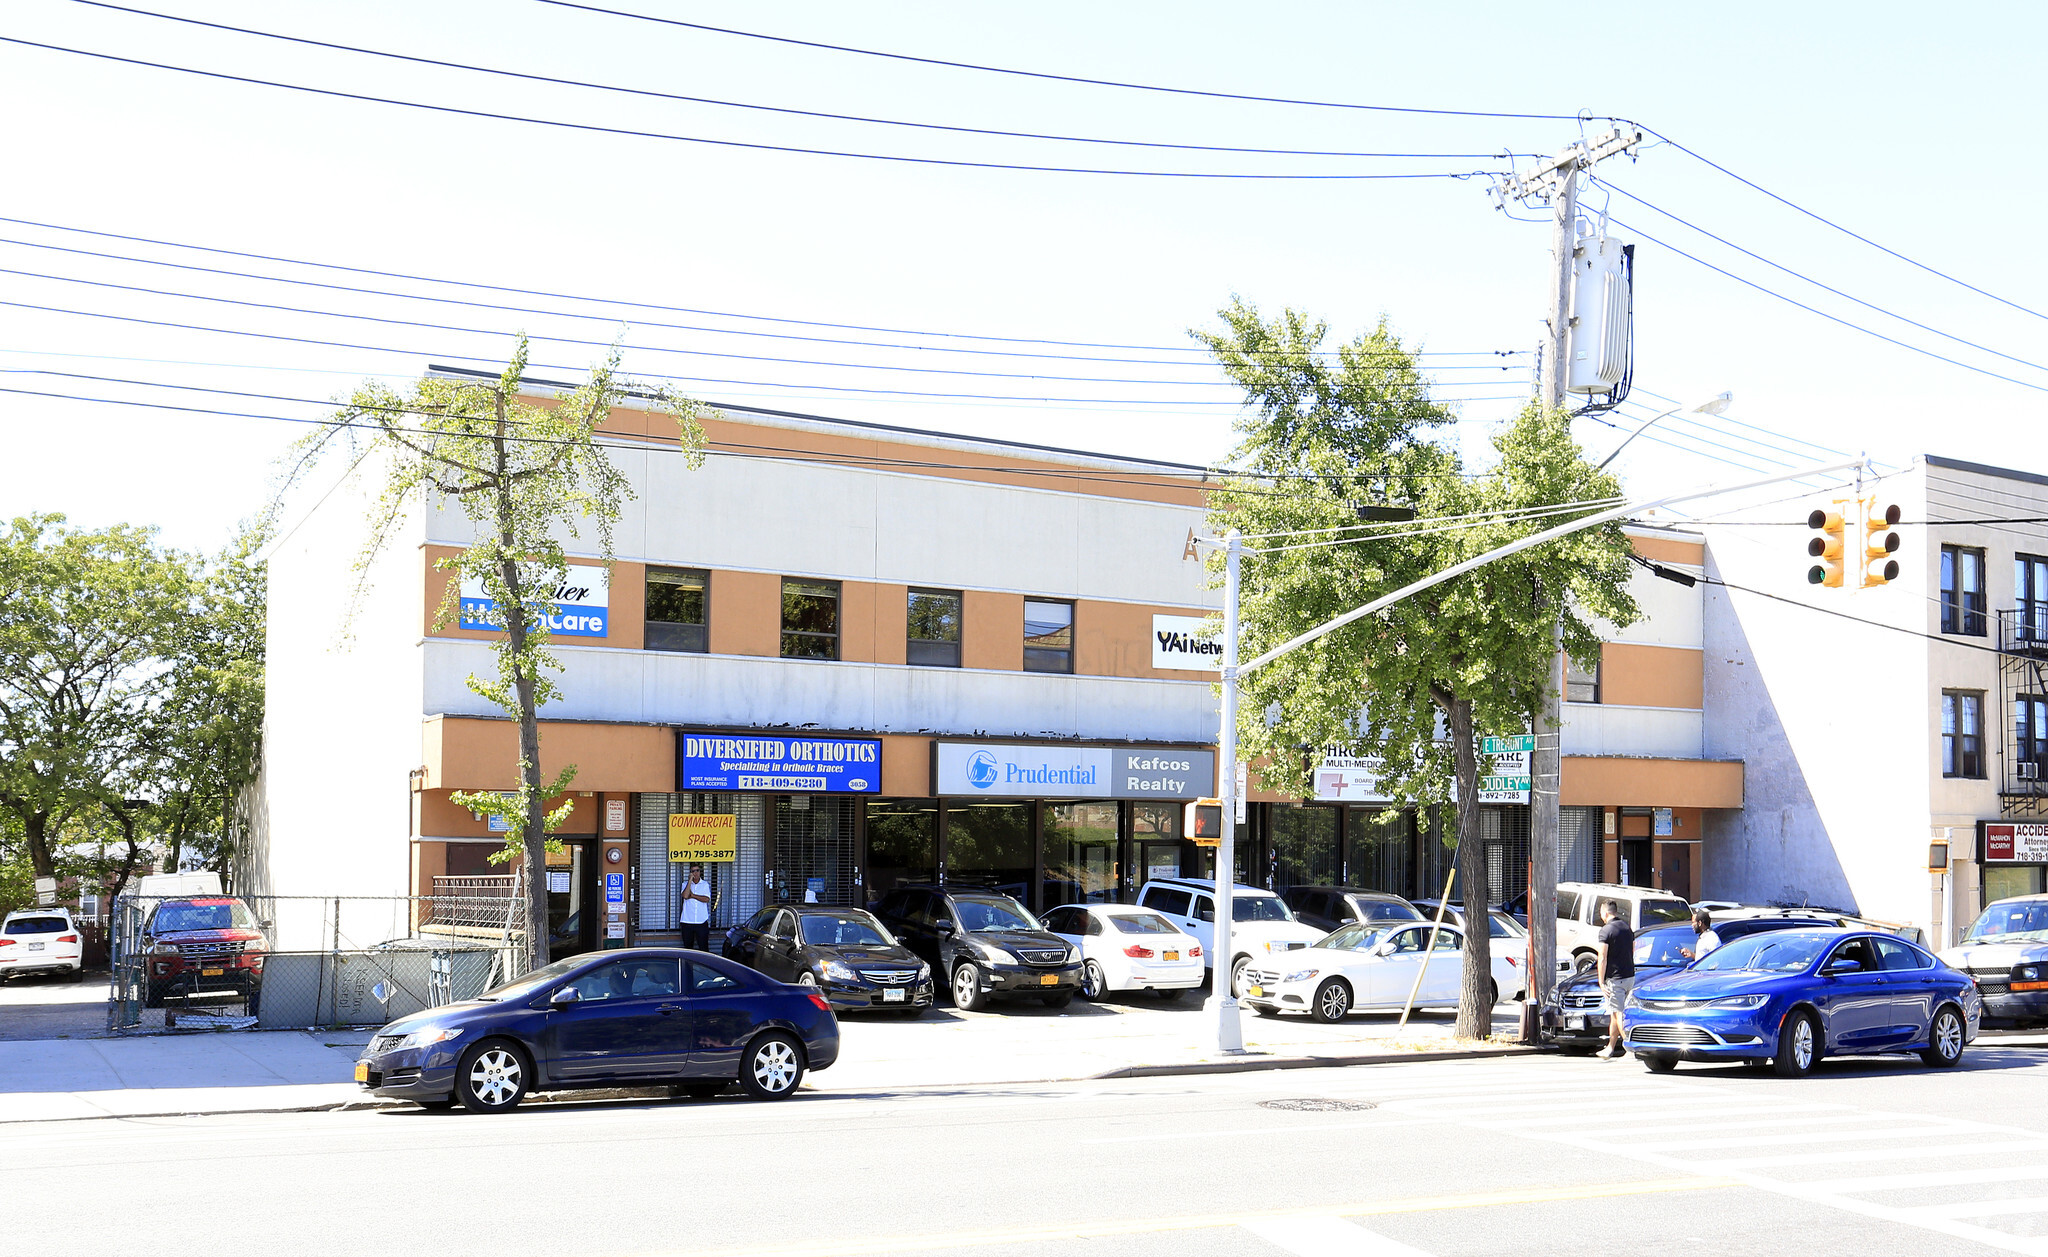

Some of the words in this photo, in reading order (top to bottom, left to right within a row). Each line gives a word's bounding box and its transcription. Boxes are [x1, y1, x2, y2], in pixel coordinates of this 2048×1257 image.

[1190, 638, 1224, 655] Netw
[686, 738, 785, 760] DIVERSIFIED
[790, 741, 876, 763] ORTHOTICS
[1485, 739, 1489, 752] E
[720, 761, 770, 773] Specializing
[772, 763, 780, 772] in
[782, 763, 816, 773] Orthotic
[817, 764, 844, 773] Braces
[1128, 756, 1190, 771] Kafcos
[1005, 762, 1096, 785] Prudential
[742, 777, 822, 788] 718-409-6280
[1127, 776, 1185, 793] Realty
[1482, 777, 1520, 790] DUDLEY
[671, 816, 733, 828] COMMERCIAL
[688, 834, 717, 845] SPACE
[670, 850, 691, 859] (917)
[694, 850, 734, 858] 795-3877
